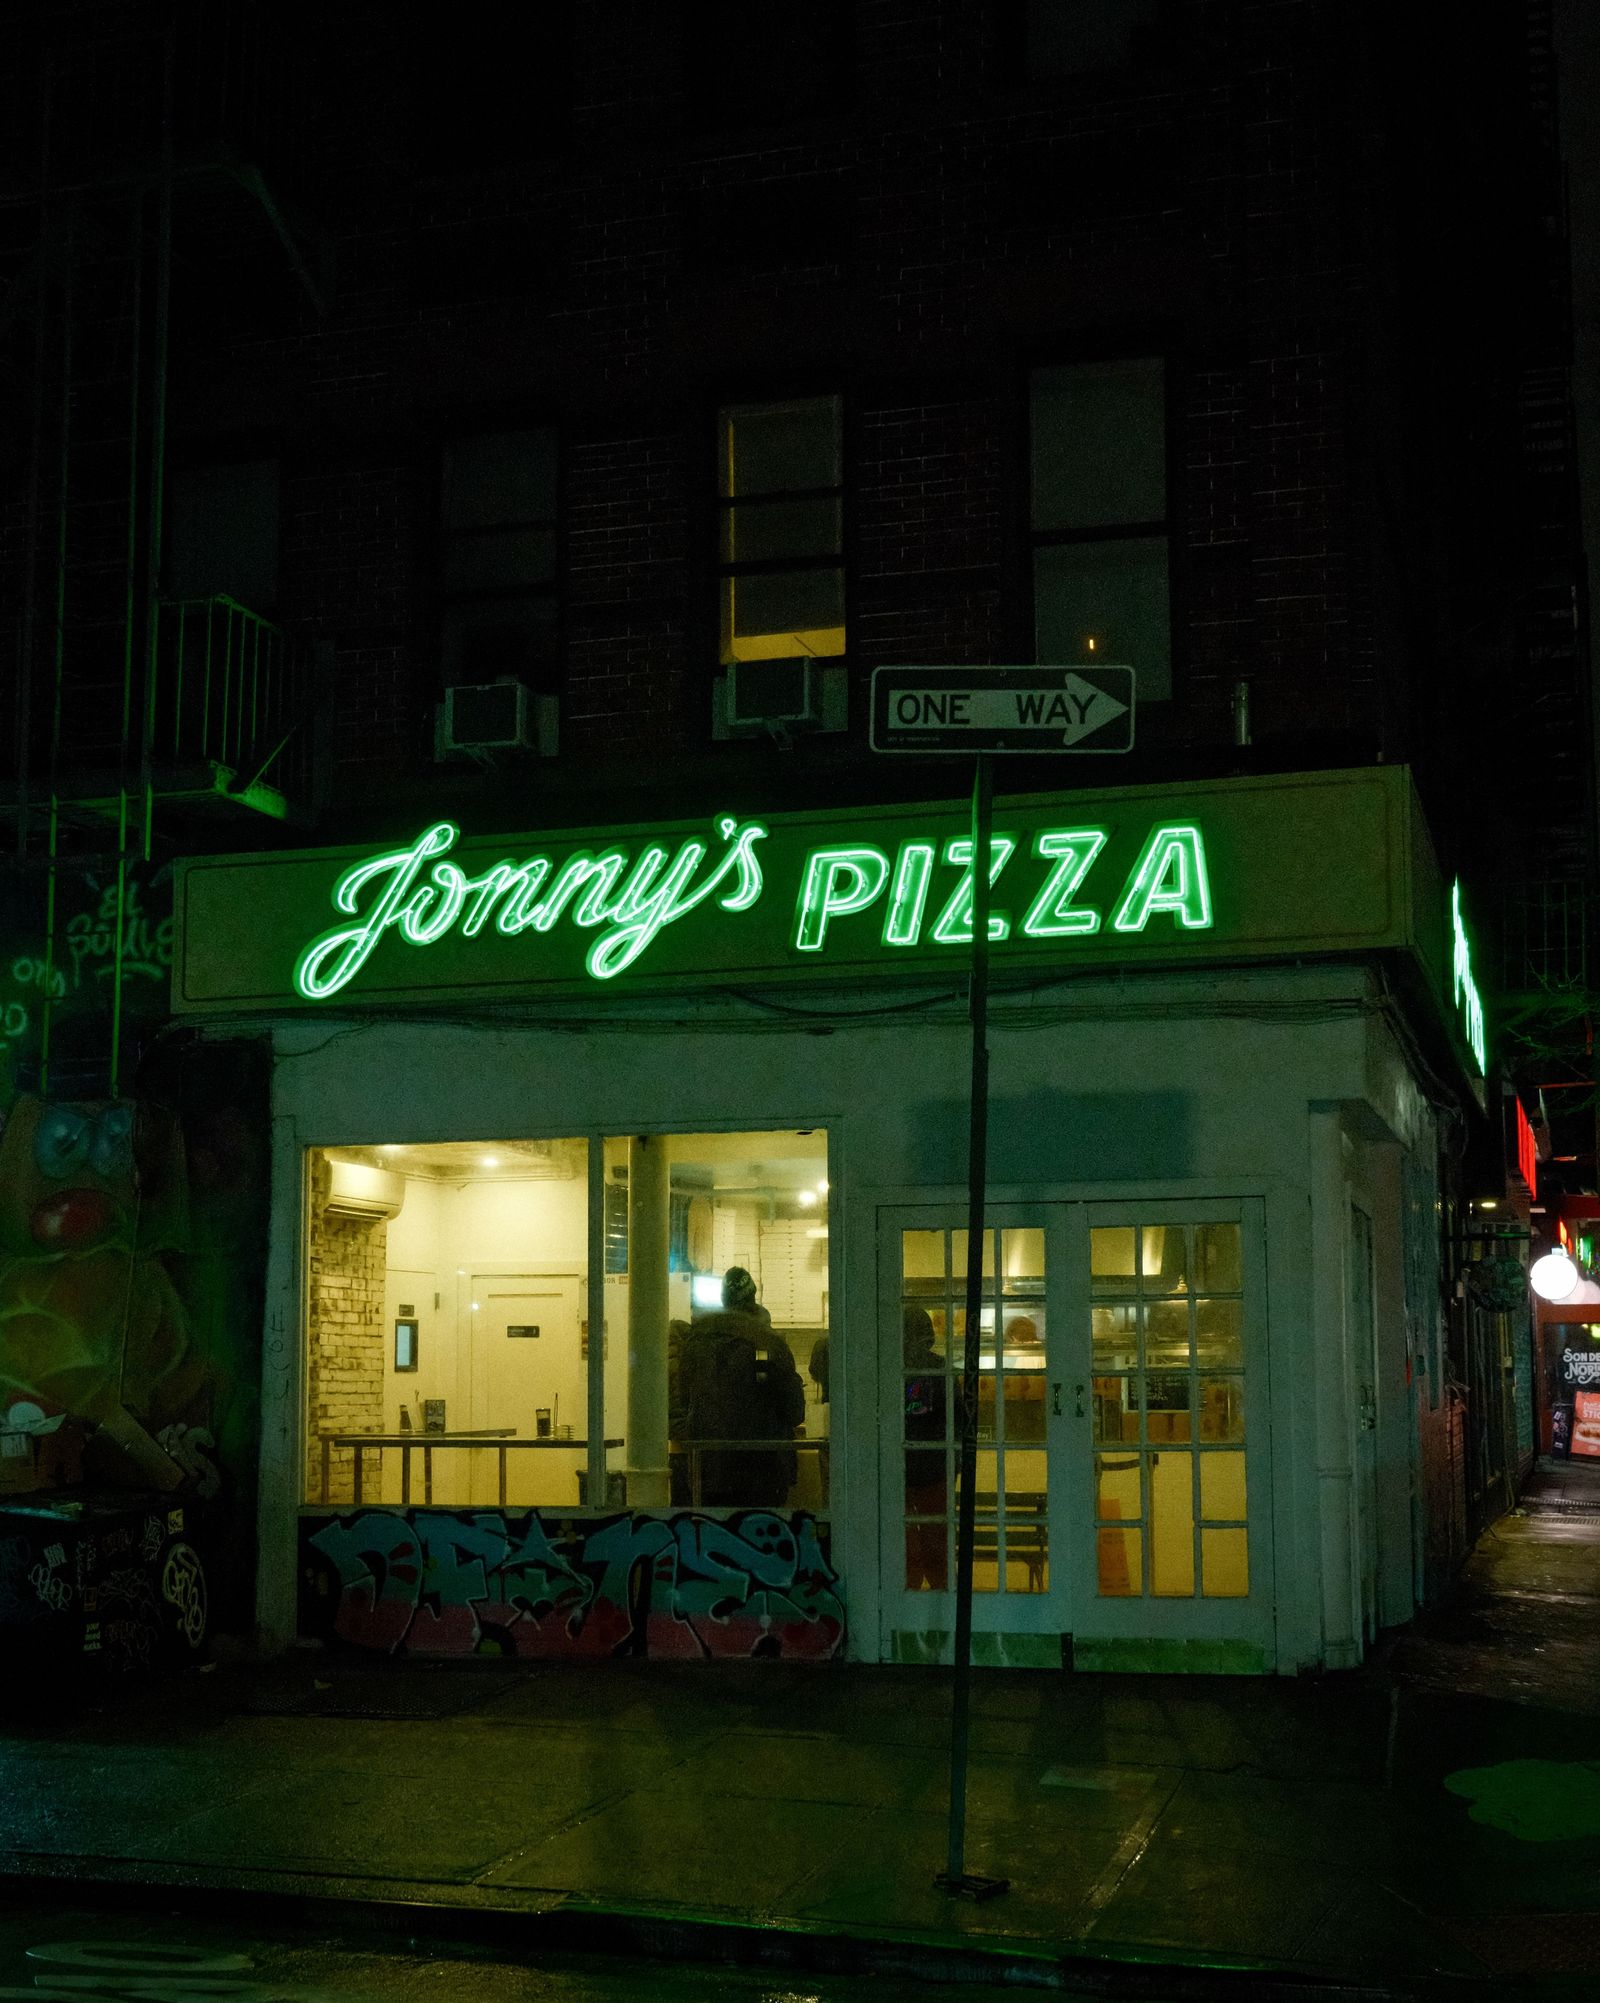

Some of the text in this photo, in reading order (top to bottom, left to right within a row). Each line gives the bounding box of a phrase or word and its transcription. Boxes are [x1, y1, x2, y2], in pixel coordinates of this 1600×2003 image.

[897, 693, 1097, 725] ONE WAY
[294, 813, 1213, 999] Jonny's PIZZA
